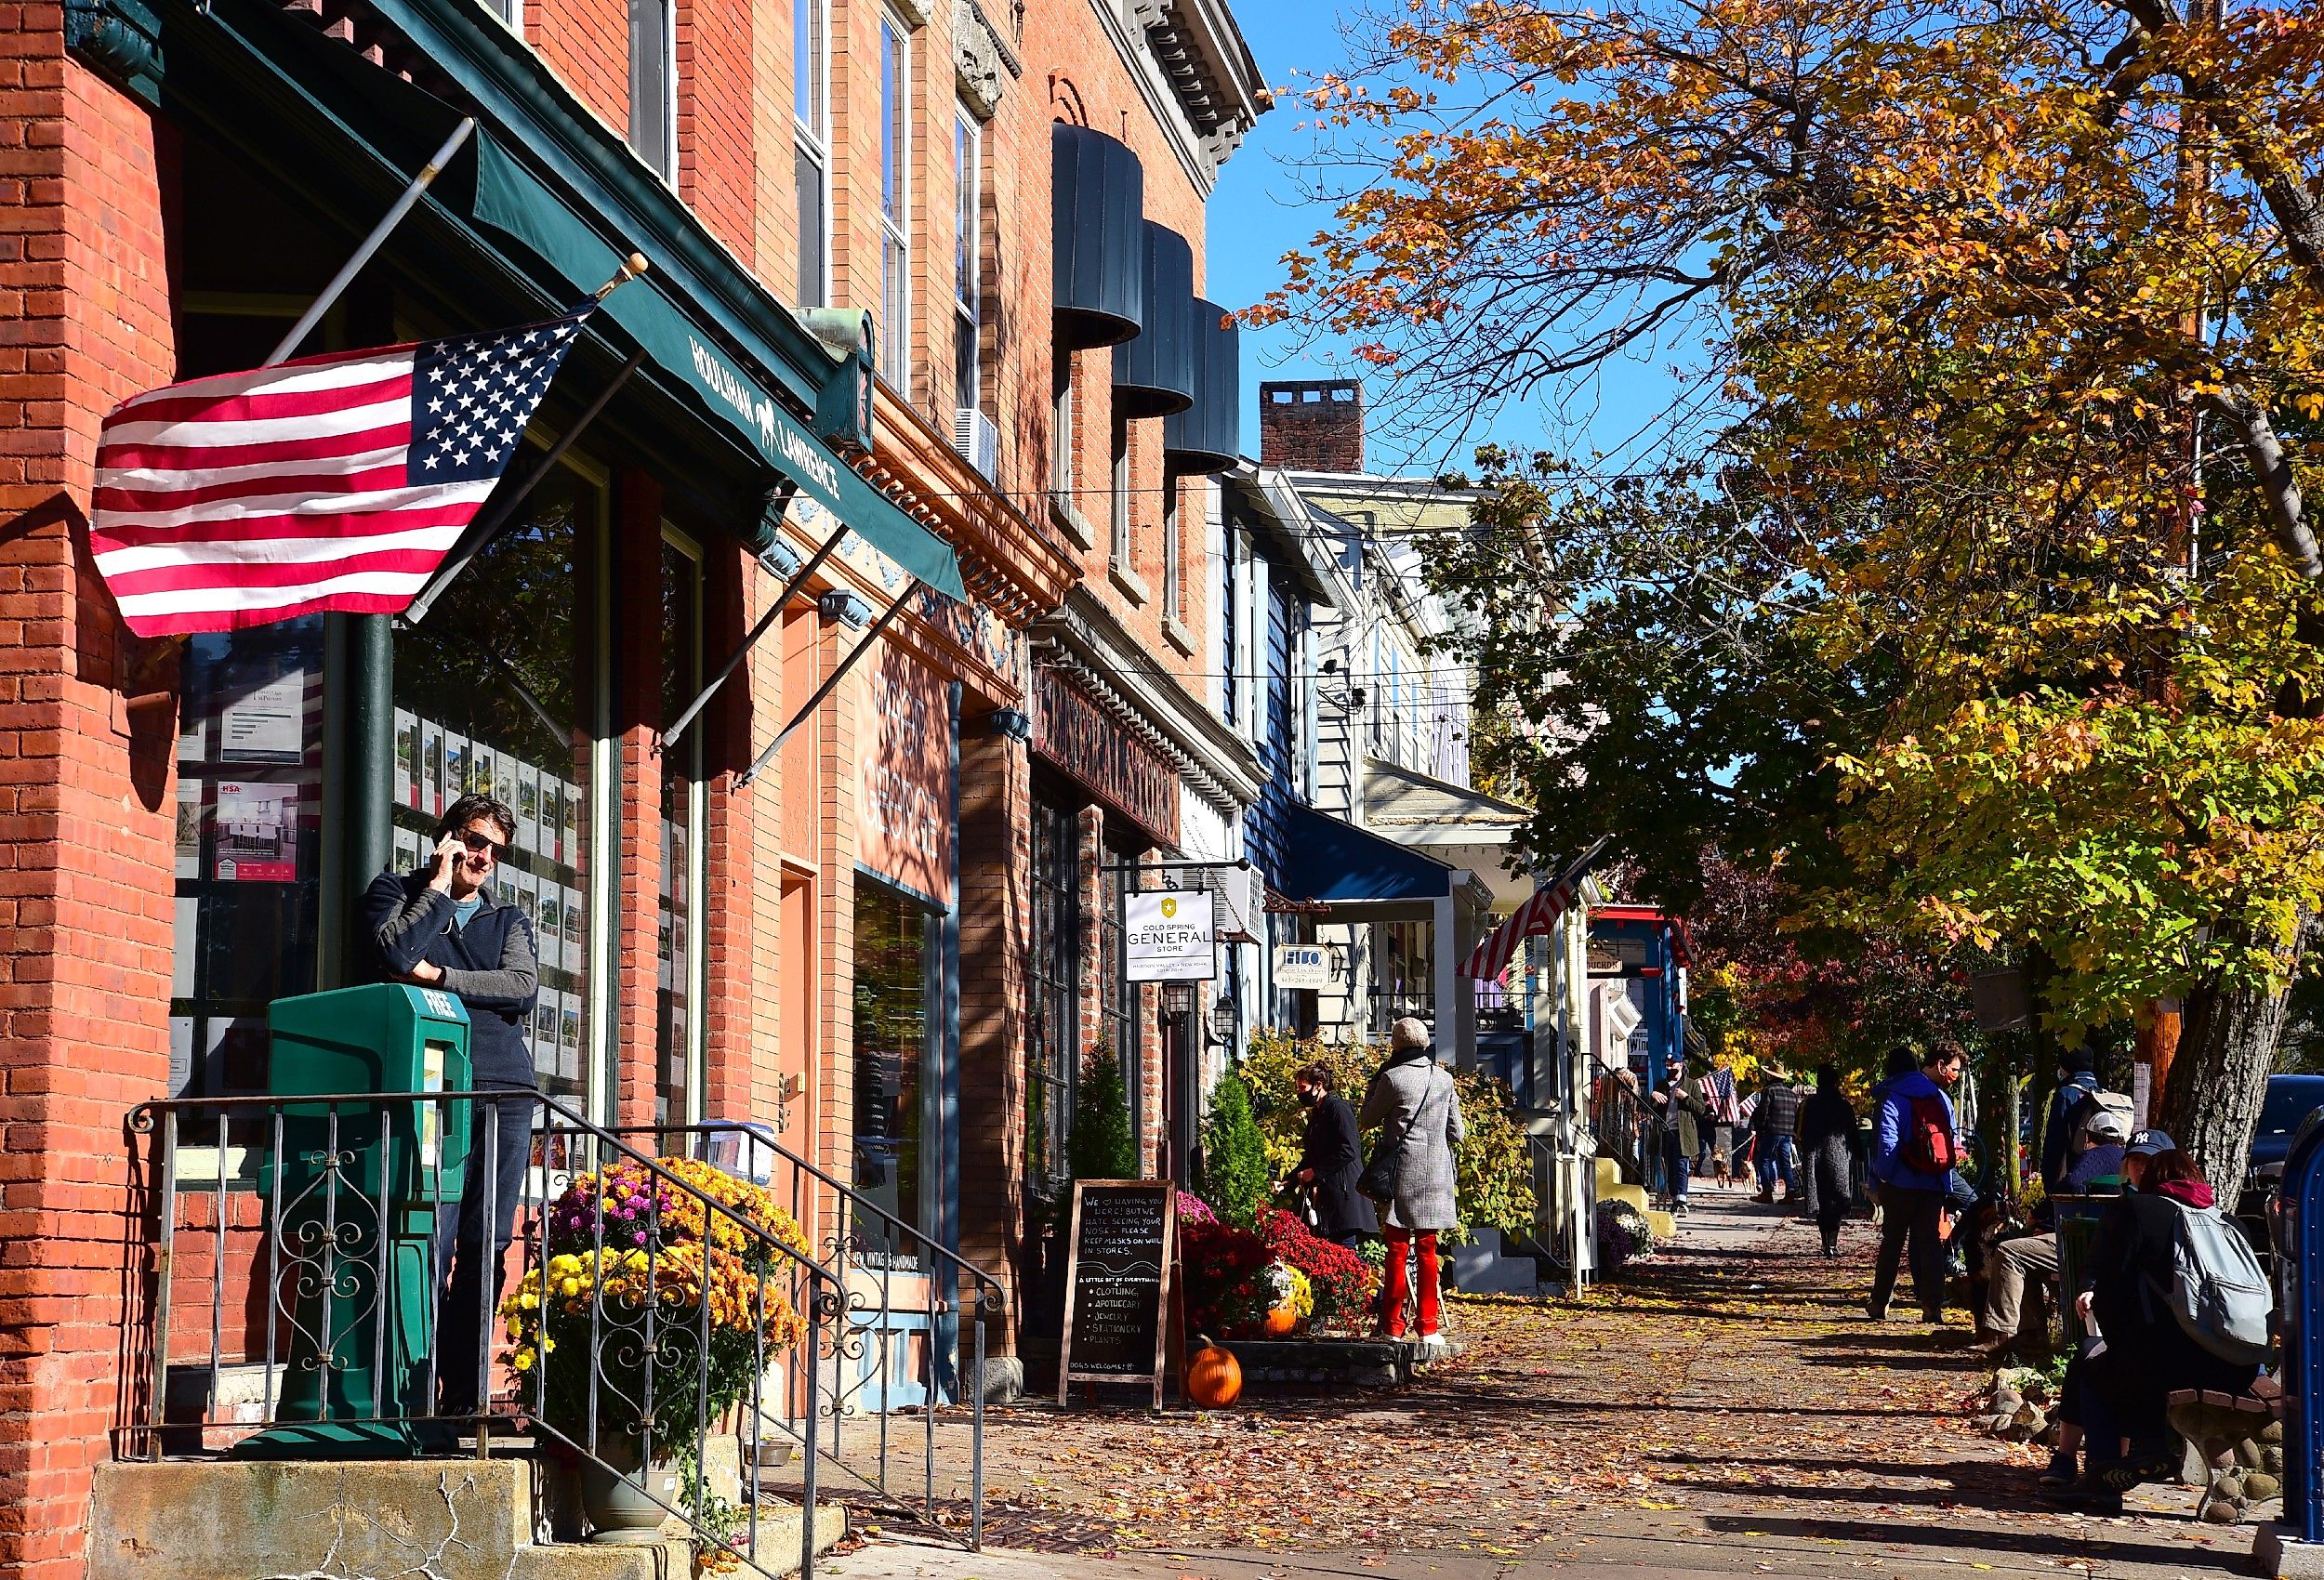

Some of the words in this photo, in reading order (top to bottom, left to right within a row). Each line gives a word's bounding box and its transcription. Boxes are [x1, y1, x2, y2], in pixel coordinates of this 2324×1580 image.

[689, 336, 754, 427] HOULIHAN
[778, 420, 840, 501] LAWRENCE
[875, 670, 925, 766] POOR
[863, 757, 937, 858] GEORGE
[1129, 931, 1211, 944] GENERAL
[420, 988, 457, 1019] FREE
[2134, 1132, 2149, 1143] NY
[1085, 1197, 1099, 1206] WE
[1142, 1218, 1161, 1226] YOUR
[1086, 1227, 1110, 1235] NOSE
[1097, 1247, 1133, 1256] STORES.
[866, 1252, 888, 1267] VINTAG
[892, 1255, 918, 1270] HANDMADE
[1096, 1287, 1139, 1298] CLOTHING
[1095, 1299, 1142, 1310] APOTHECARY
[1095, 1311, 1129, 1322] JEWELRY
[1093, 1323, 1142, 1334] STATIONERY
[1090, 1336, 1122, 1344] PLANTS
